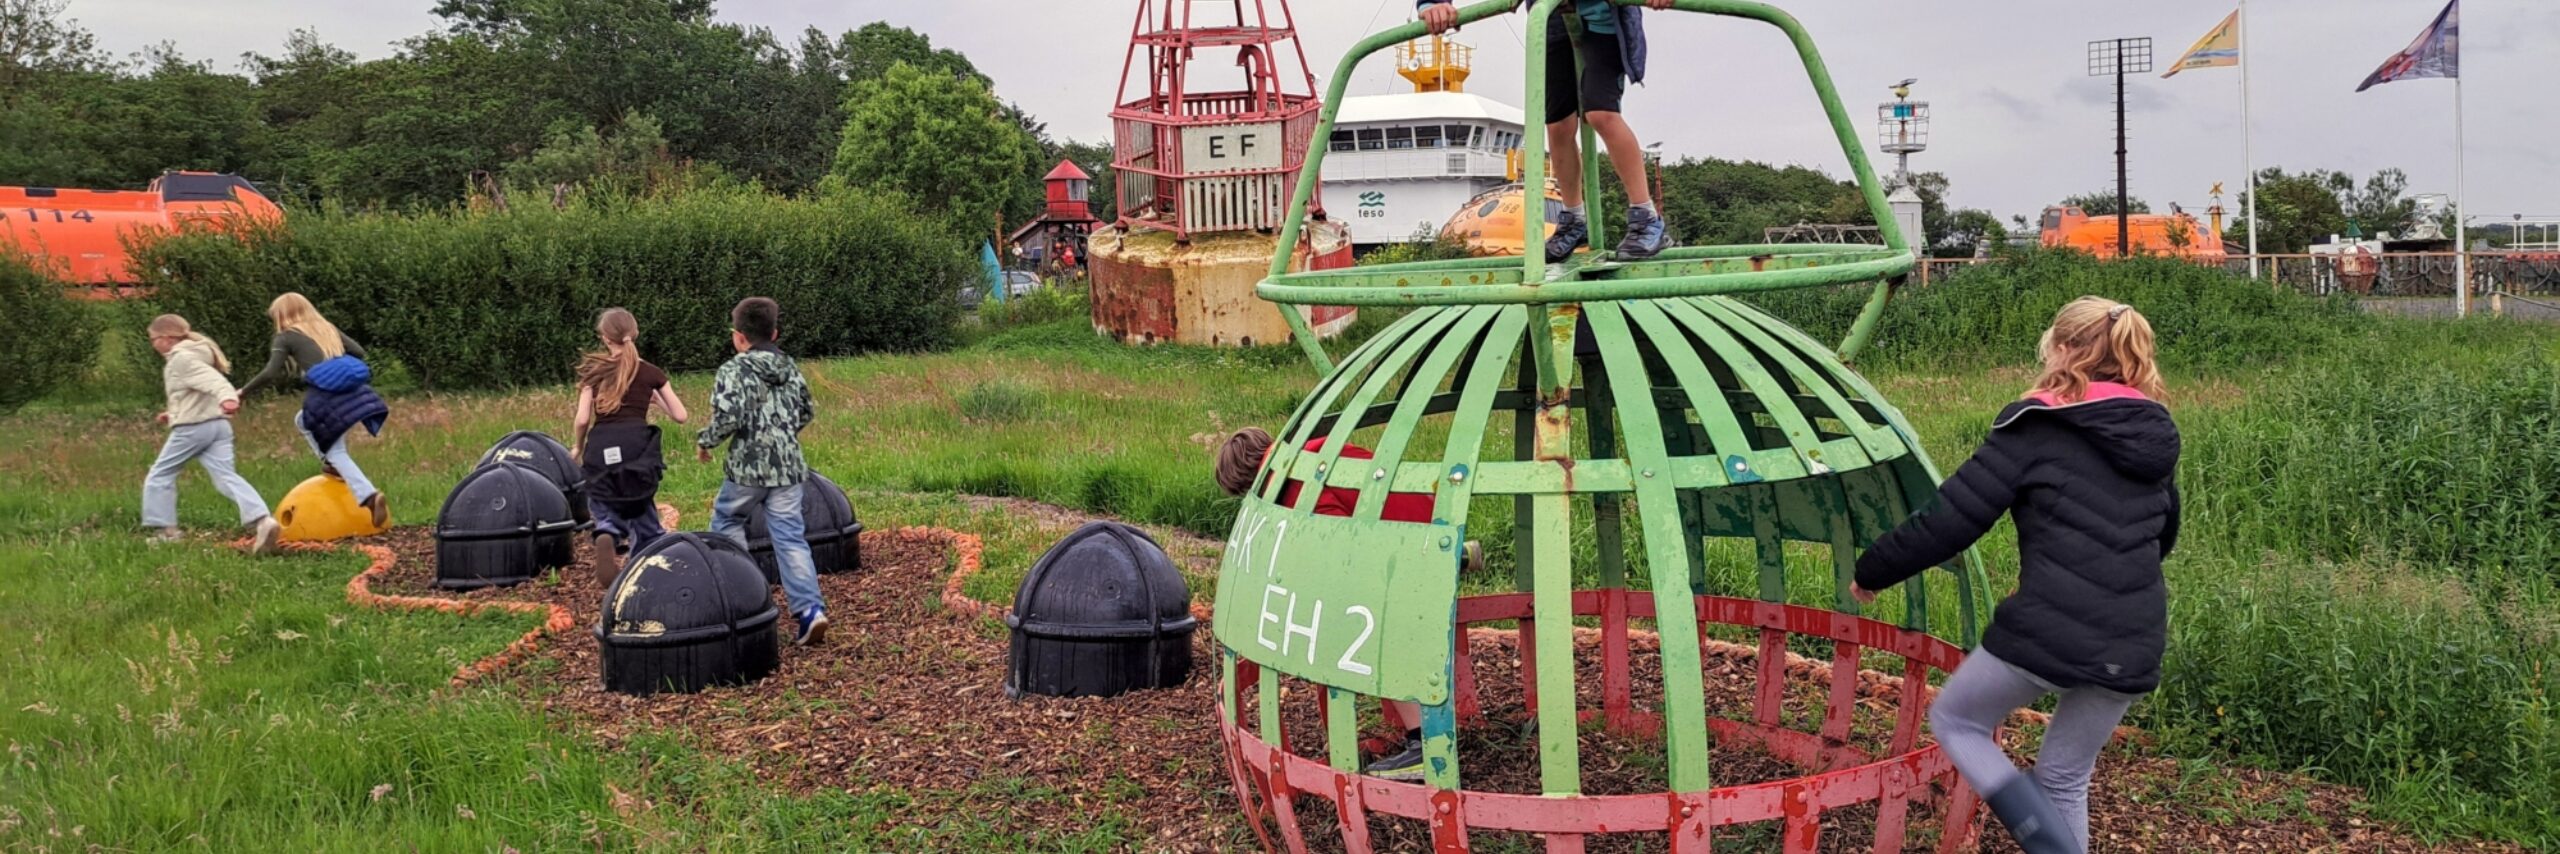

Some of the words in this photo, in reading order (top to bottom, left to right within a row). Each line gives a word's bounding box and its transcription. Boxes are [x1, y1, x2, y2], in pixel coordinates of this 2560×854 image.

[21, 207, 95, 223] 114
[1358, 208, 1385, 218] teso
[1229, 506, 1267, 573] AK
[1268, 519, 1288, 577] 1
[1257, 583, 1323, 666] EH
[1337, 605, 1375, 676] 2
